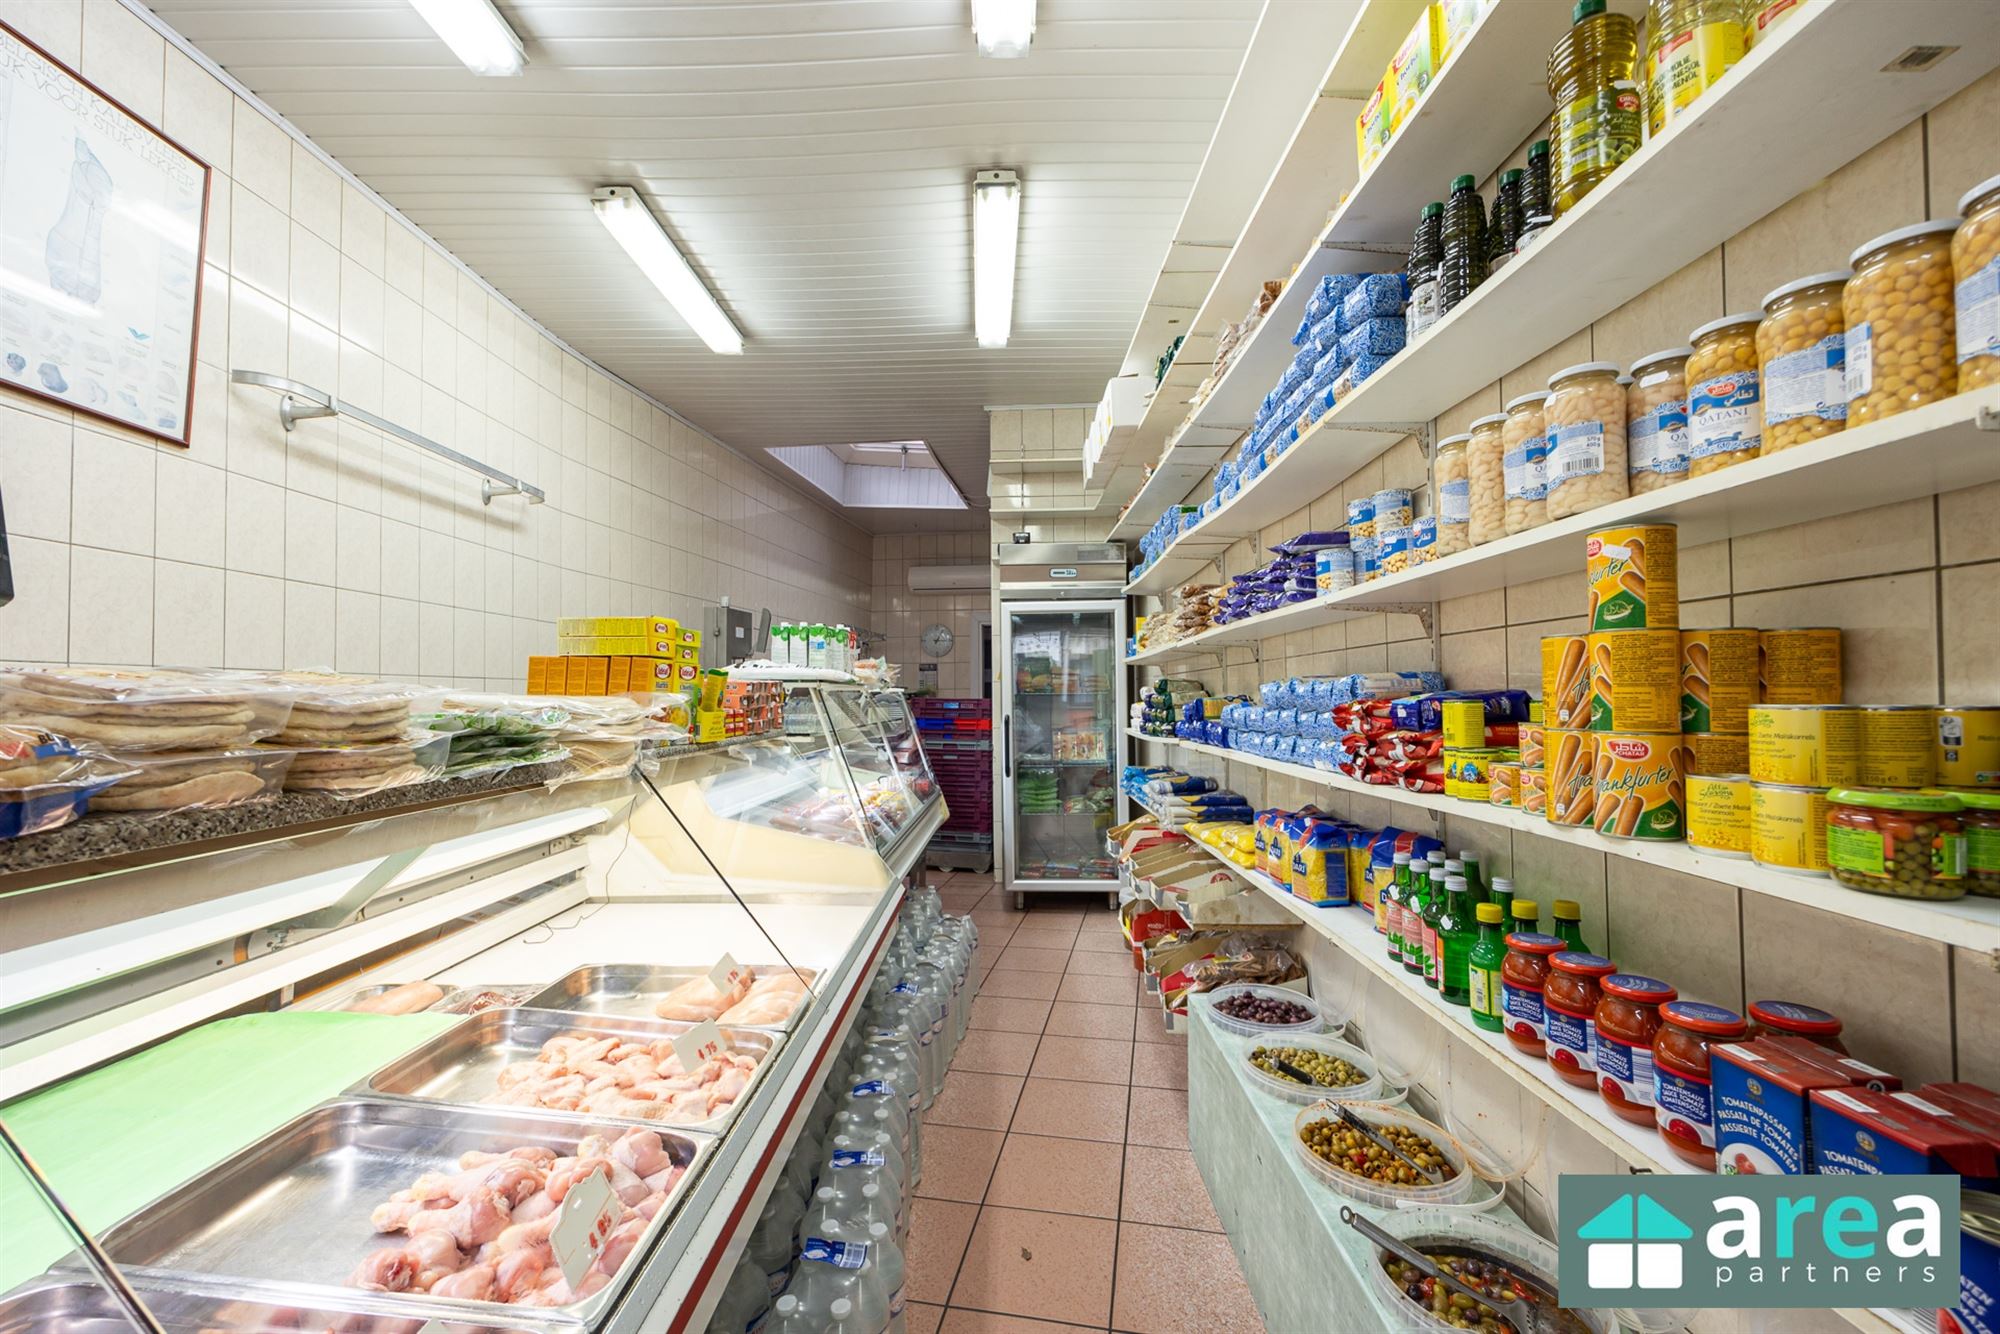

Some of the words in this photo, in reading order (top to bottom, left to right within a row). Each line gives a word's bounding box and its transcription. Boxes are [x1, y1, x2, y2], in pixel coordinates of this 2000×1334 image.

[1699, 408, 1748, 426] QATANI
[1614, 742, 1645, 753] شاطر
[1662, 1082, 1704, 1104] TOMATENSAUS
[1679, 1092, 1706, 1110] TOMATE
[1721, 1096, 1792, 1139] TOMATENPASSATA
[1717, 1109, 1748, 1122] PASSATA
[1750, 1116, 1761, 1128] DE
[1763, 1123, 1799, 1160] TOMATES
[1720, 1123, 1758, 1138] PASSIERTE
[1760, 1133, 1798, 1173] TOMATEN
